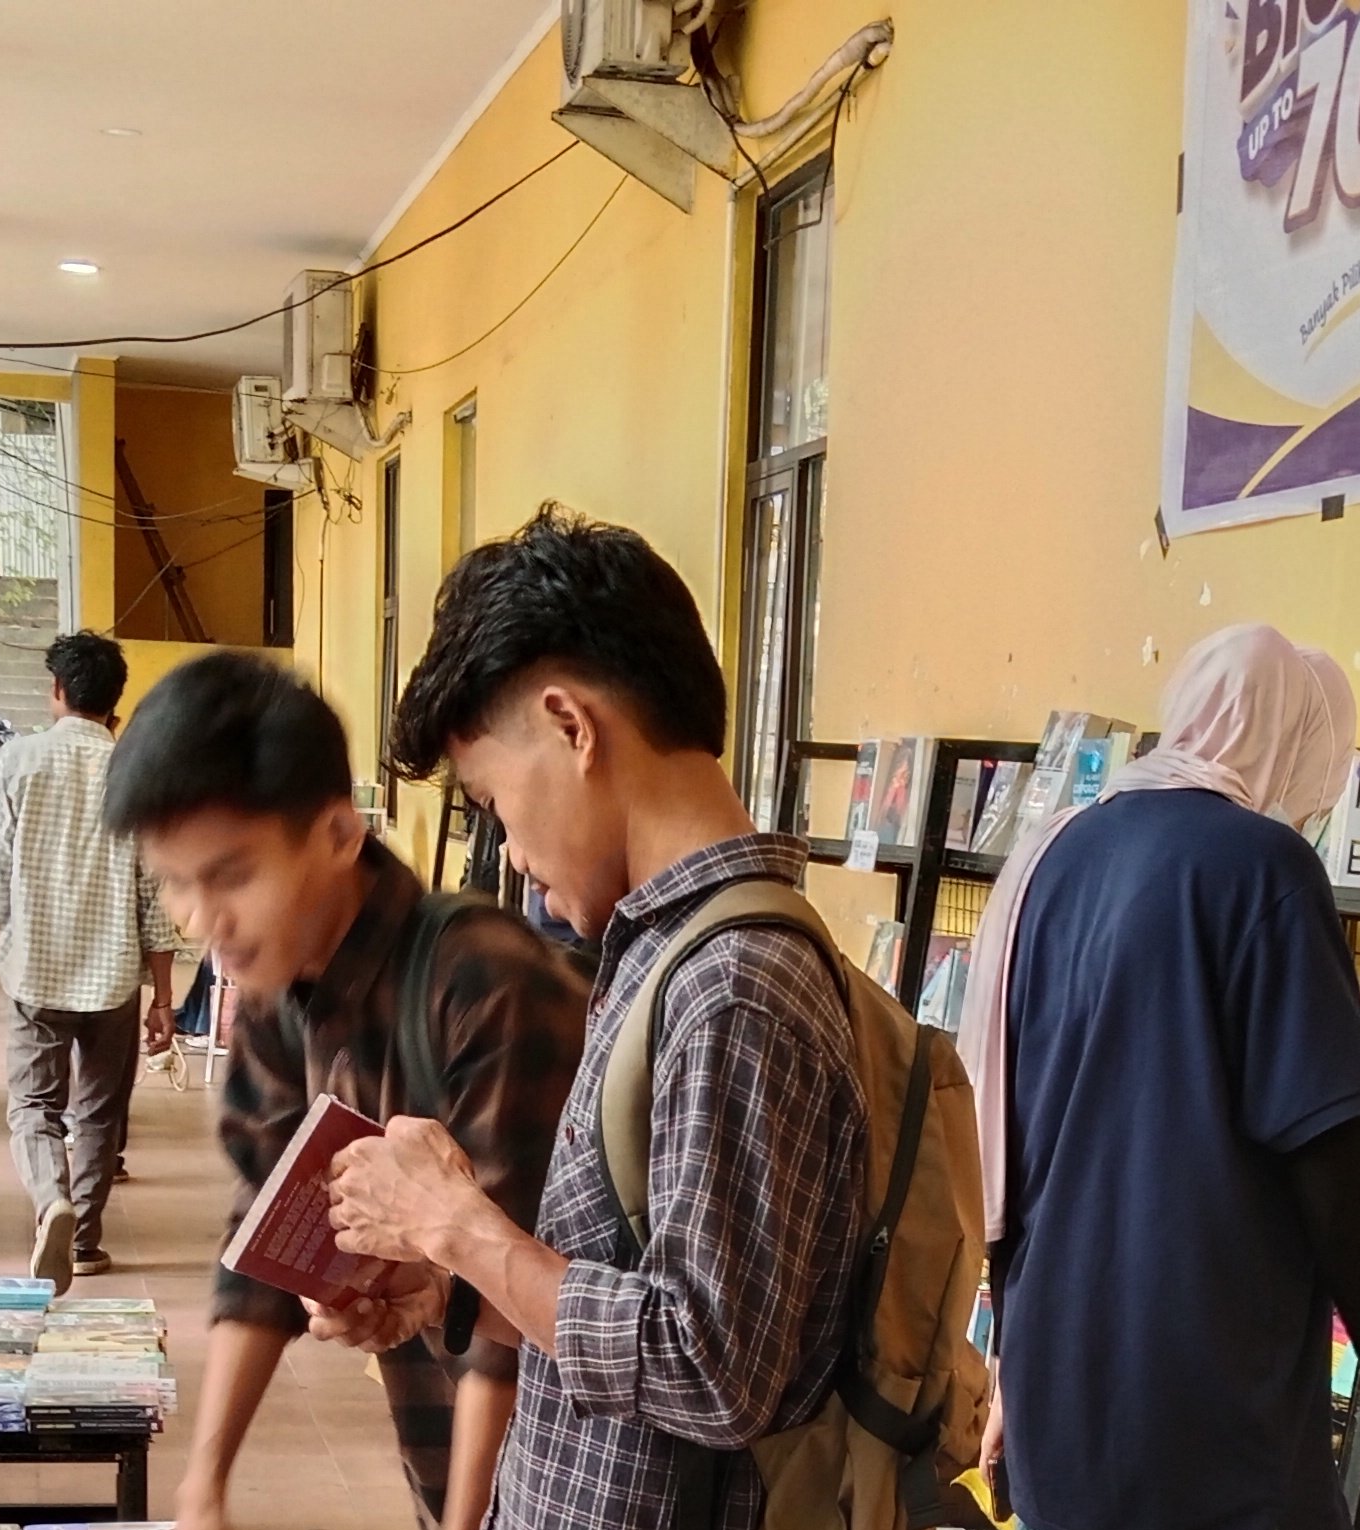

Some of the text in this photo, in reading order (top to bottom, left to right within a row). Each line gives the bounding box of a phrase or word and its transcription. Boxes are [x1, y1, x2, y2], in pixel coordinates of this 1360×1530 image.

[1248, 88, 1294, 160] UP TO
[1299, 281, 1340, 346] Banyak
